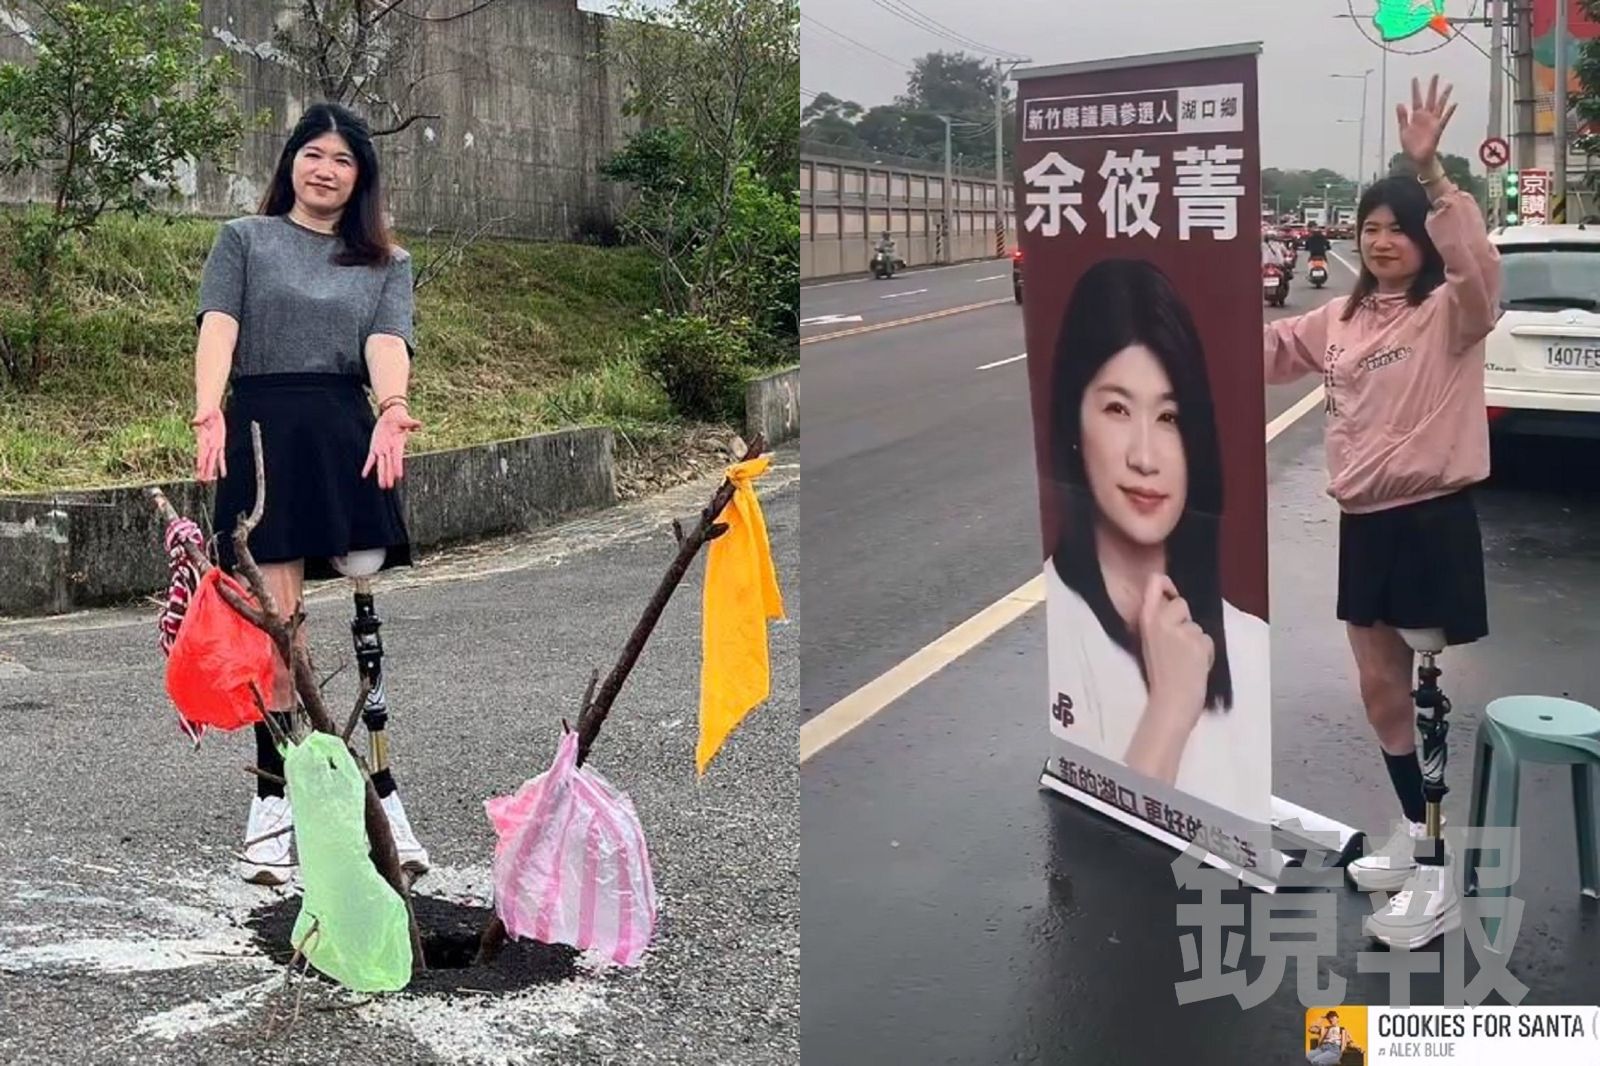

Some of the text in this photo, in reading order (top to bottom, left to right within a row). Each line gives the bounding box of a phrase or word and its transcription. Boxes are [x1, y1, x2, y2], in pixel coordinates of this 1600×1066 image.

[1028, 97, 1238, 131] 新竹縣議員參選人 湖口鄉
[1023, 145, 1246, 241] 余筱菁
[1058, 756, 1137, 814] 新的湖口
